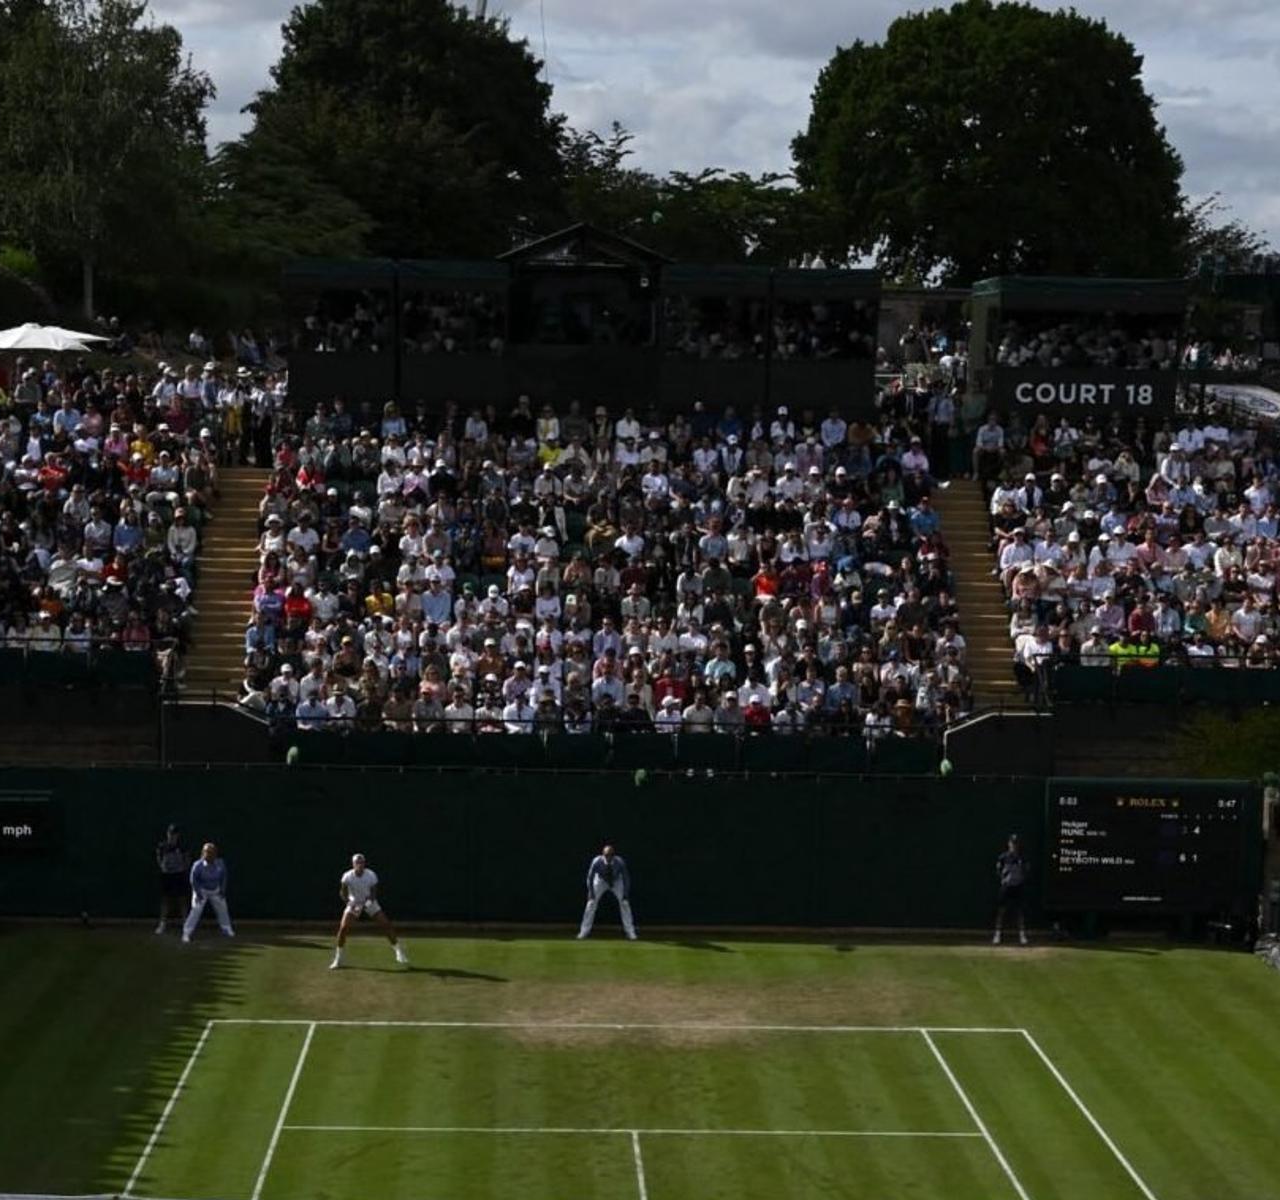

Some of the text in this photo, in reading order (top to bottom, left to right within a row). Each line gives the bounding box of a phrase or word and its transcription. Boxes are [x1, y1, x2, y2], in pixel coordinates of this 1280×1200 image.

[1014, 382, 1154, 406] COURT 18
[1129, 797, 1166, 808] ROLEX
[2, 823, 33, 839] mph
